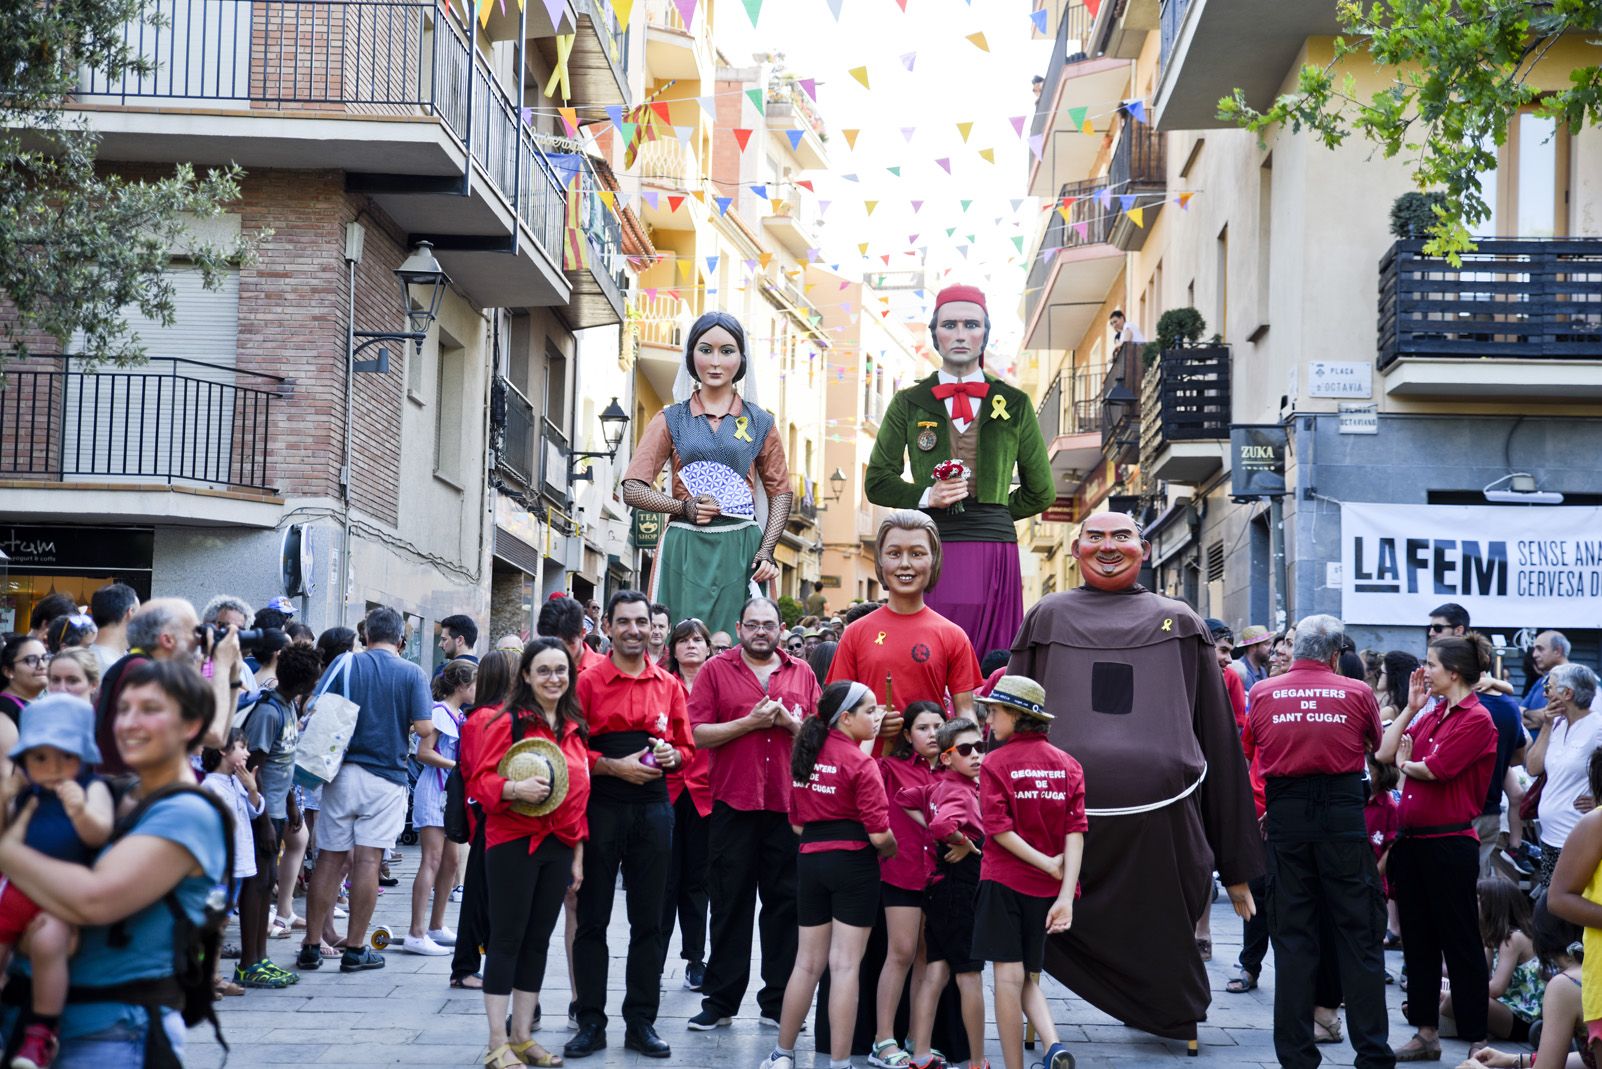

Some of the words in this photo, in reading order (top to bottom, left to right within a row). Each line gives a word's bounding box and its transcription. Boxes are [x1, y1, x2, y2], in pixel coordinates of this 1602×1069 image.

[1240, 445, 1275, 459] ZUKA
[638, 513, 658, 521] TEA
[1517, 540, 1569, 567] SENSE
[1517, 570, 1585, 597] CERVESA
[1590, 570, 1602, 597] D
[1272, 688, 1347, 699] GEGANTERS
[1300, 700, 1318, 710] DE
[1272, 713, 1304, 724] SANT
[1306, 713, 1348, 724] CUGAT
[811, 783, 837, 795] CUGAT
[1035, 780, 1049, 788] DE
